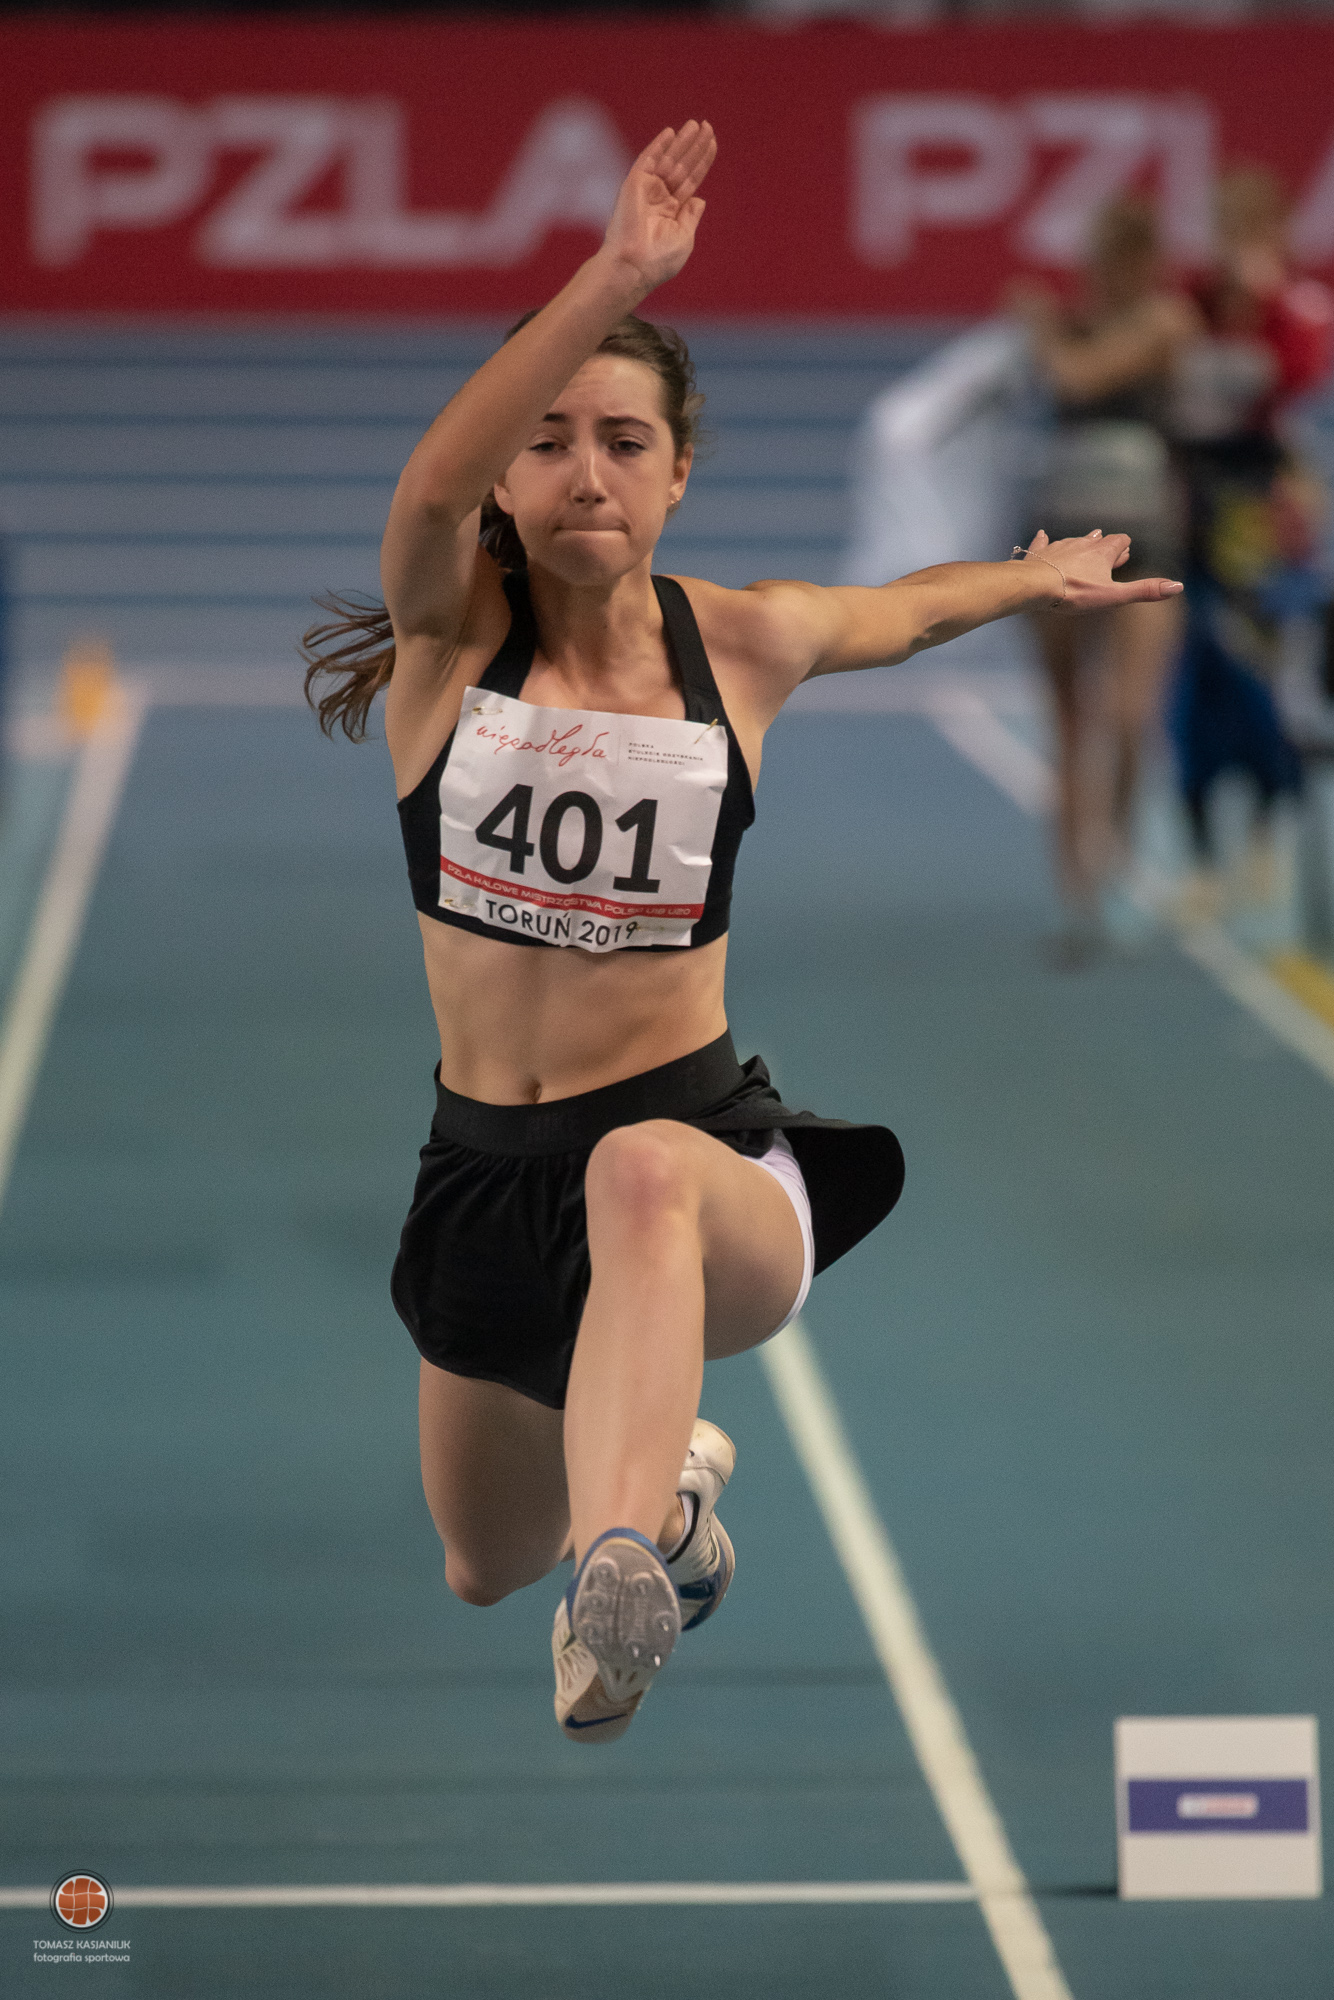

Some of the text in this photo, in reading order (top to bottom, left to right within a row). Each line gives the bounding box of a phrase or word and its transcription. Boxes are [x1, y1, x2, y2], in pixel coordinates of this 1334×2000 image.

[31, 93, 635, 268] PZLA
[475, 783, 661, 893] 401
[447, 864, 472, 881] PZLA
[473, 876, 519, 896] HALOWE
[485, 899, 638, 946] TORUŃ 2019
